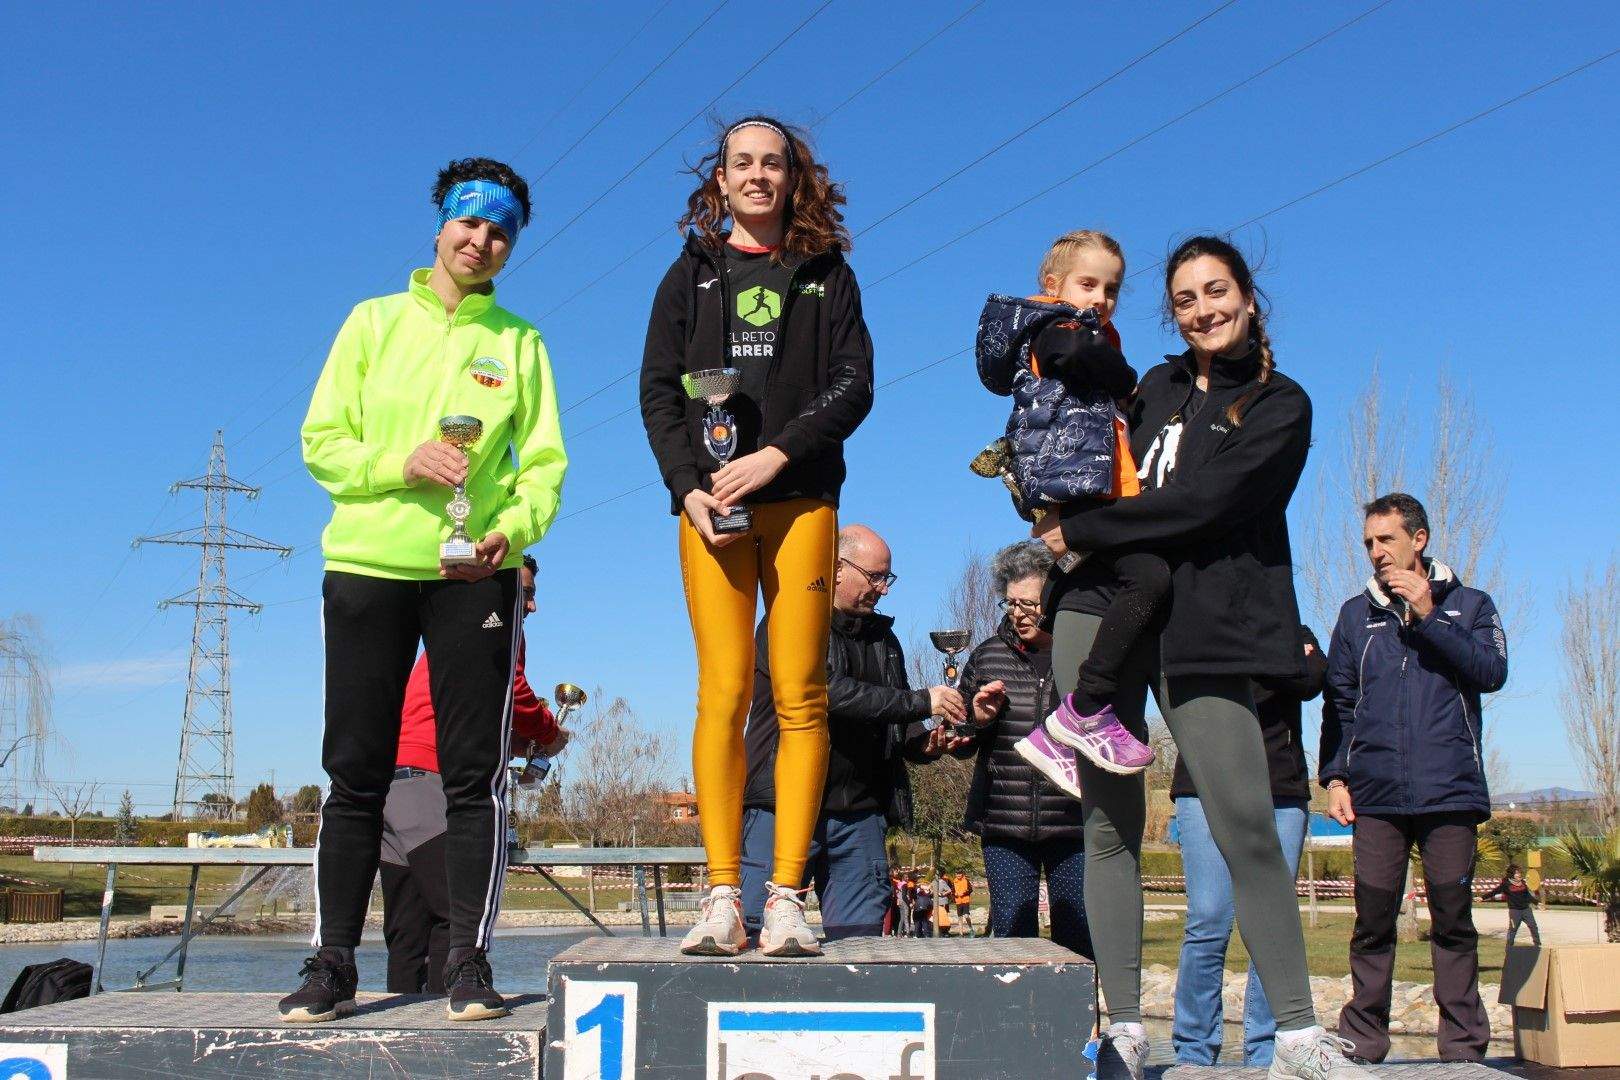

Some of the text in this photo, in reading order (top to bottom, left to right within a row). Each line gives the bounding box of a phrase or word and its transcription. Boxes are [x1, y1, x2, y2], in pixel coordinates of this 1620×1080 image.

[730, 331, 776, 343] L RETO
[731, 344, 774, 358] RRER
[575, 993, 625, 1080] 1
